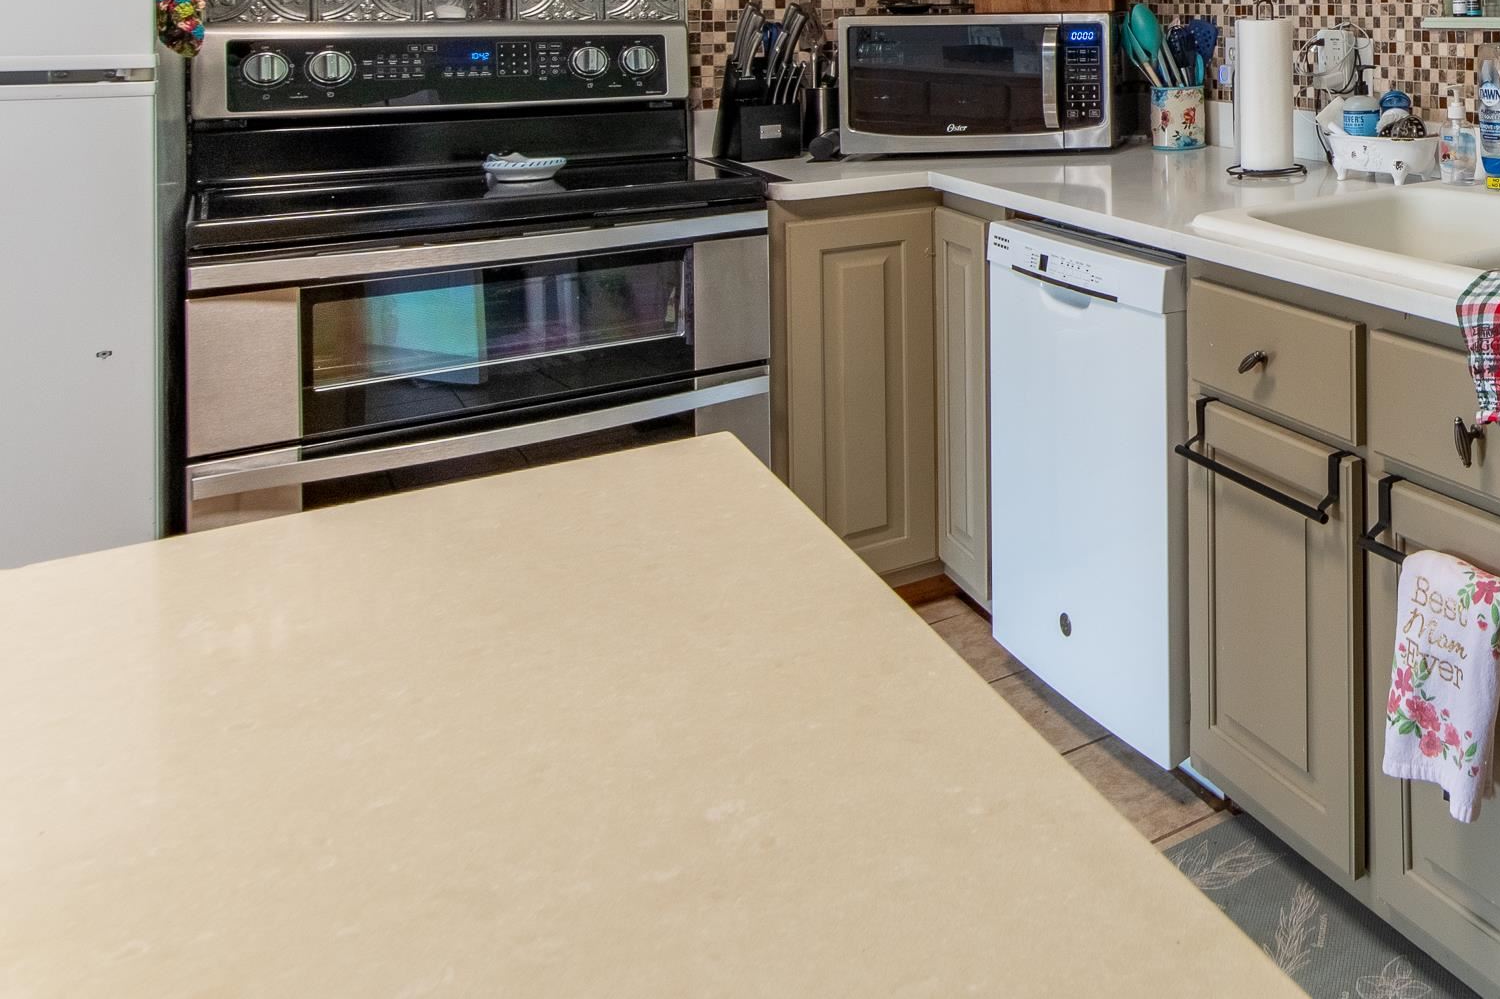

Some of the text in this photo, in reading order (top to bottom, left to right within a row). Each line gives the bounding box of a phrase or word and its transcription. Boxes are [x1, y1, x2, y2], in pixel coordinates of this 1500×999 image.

[946, 123, 968, 133] Oster
[1411, 575, 1468, 628] Best
[1405, 636, 1464, 690] Ever
